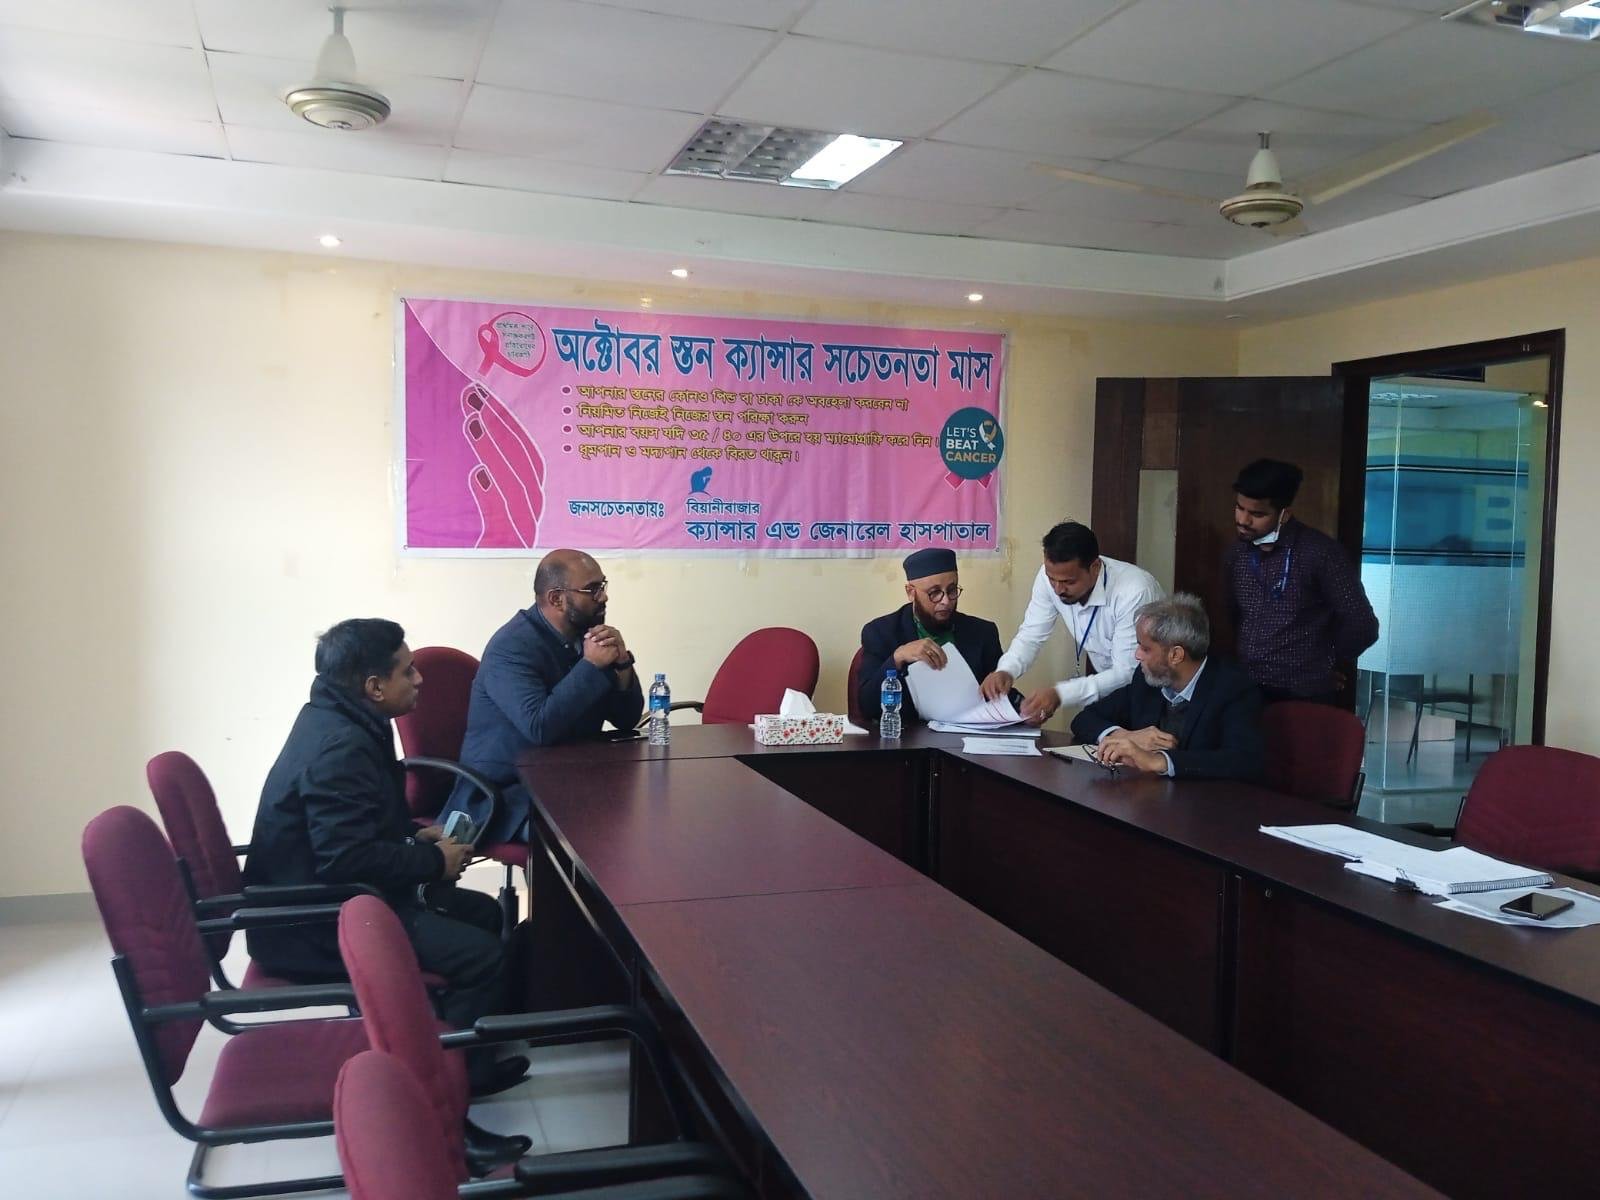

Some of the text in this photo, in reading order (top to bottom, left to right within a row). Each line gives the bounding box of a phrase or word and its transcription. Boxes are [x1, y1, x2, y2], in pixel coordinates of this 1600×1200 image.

[551, 318, 994, 391] অক্টোবর স্তন ক্যান্সার সচেতনতা মাস
[576, 386, 627, 401] আপনার
[630, 388, 665, 402] স্তনের
[668, 389, 709, 403] কোনও
[740, 393, 753, 406] বা
[757, 393, 783, 406] চাকা
[786, 394, 803, 407] কে
[805, 395, 852, 409] অবহেলা
[854, 397, 894, 411] করবেন
[894, 398, 909, 412] না
[577, 402, 625, 418] নিয়মিত
[628, 404, 669, 422] নিজেই
[672, 406, 711, 422] নিজের
[713, 410, 734, 423] স্তন
[777, 413, 809, 425] করুন
[577, 424, 627, 439] আপনার
[630, 427, 659, 440] বয়স
[662, 426, 685, 441] যদি
[688, 429, 709, 441] ৩৫
[721, 430, 742, 442] ৪০
[746, 430, 766, 443] এর
[803, 431, 822, 445] হয়
[886, 433, 910, 447] করে
[911, 432, 932, 447] নিন
[946, 427, 977, 438] LET'S
[624, 445, 637, 458] ও
[690, 446, 721, 460] থেকে
[725, 445, 757, 460] বিরত
[945, 438, 979, 450] BEAT
[945, 451, 997, 463] CANCER
[685, 497, 761, 515] বিয়ানীবাজার
[685, 520, 758, 541] ক্যান্সার
[810, 520, 891, 541] জেনারেল
[898, 521, 991, 543] হাসপাতাল
